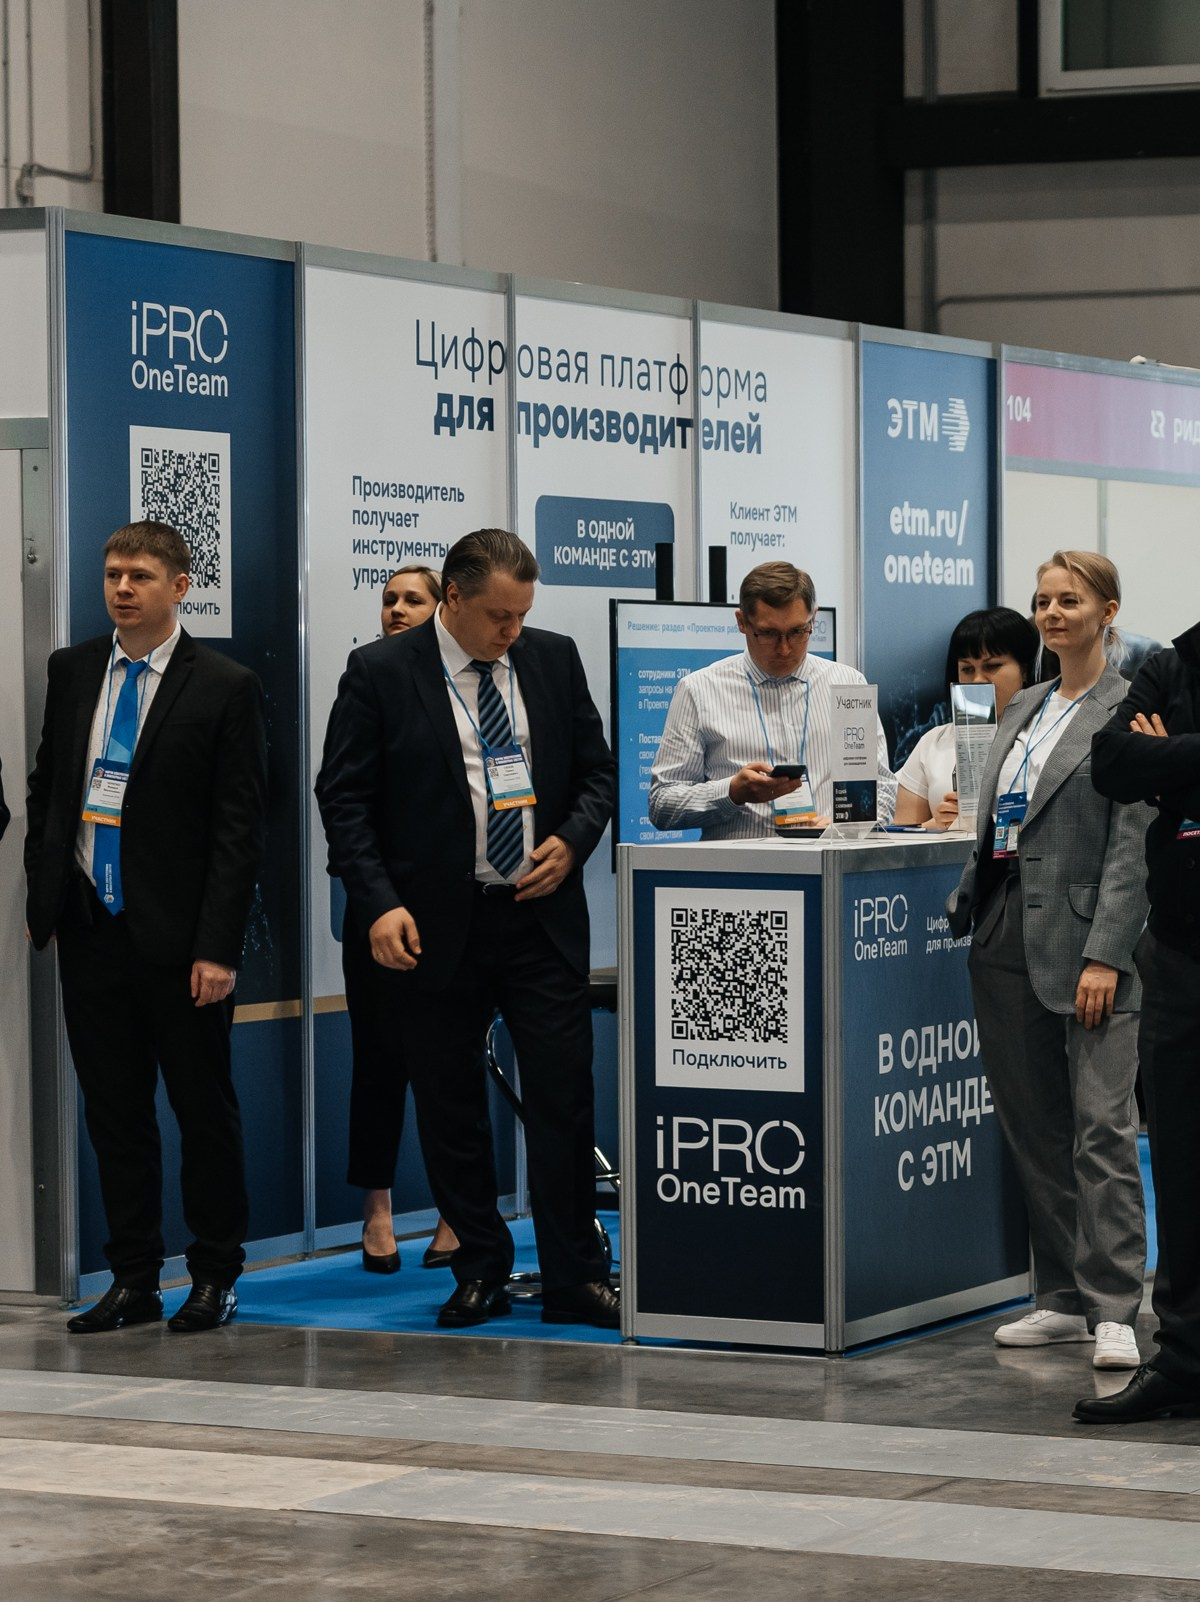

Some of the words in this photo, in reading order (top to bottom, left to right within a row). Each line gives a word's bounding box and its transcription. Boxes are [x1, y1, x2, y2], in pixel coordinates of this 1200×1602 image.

[131, 300, 228, 364] iPRO
[415, 319, 588, 385] Цифровая
[600, 353, 767, 408] платформа
[131, 359, 228, 397] OneTeam
[887, 398, 939, 442] ЭТМ
[1007, 394, 1031, 422] 104
[433, 392, 494, 437] для
[517, 400, 762, 455] производителей
[352, 475, 465, 504] Производитель
[352, 509, 419, 533] получает
[729, 501, 770, 522] Клиент
[773, 507, 798, 524] ЭТМ
[889, 499, 969, 546] etm.ru/
[577, 519, 585, 538] В
[588, 517, 635, 543] ОДНОЙ
[729, 529, 786, 552] получает:
[352, 538, 451, 563] инструменты
[554, 545, 617, 570] КОМАНДЕ
[619, 548, 629, 567] С
[631, 549, 656, 568] ЭТМ
[884, 550, 975, 586] oneteam
[177, 601, 221, 615] лючить
[627, 620, 660, 631] Решение:
[661, 623, 685, 633] раздел
[638, 670, 675, 681] сотрудники
[638, 685, 663, 696] запросы
[836, 695, 872, 709] Участник
[643, 698, 669, 711] Проекте
[854, 894, 908, 938] iPRO
[926, 915, 949, 934] Цифр
[854, 937, 908, 961] OneTeam
[925, 940, 940, 954] для
[943, 935, 973, 952] произв
[672, 1048, 788, 1070] Подключить
[878, 1033, 894, 1075] В
[874, 1075, 994, 1137] КОМАНДЕ
[656, 1115, 806, 1175] iPRO
[898, 1150, 915, 1191] С
[921, 1137, 971, 1186] ЭТМ
[656, 1173, 806, 1209] OneTeam
